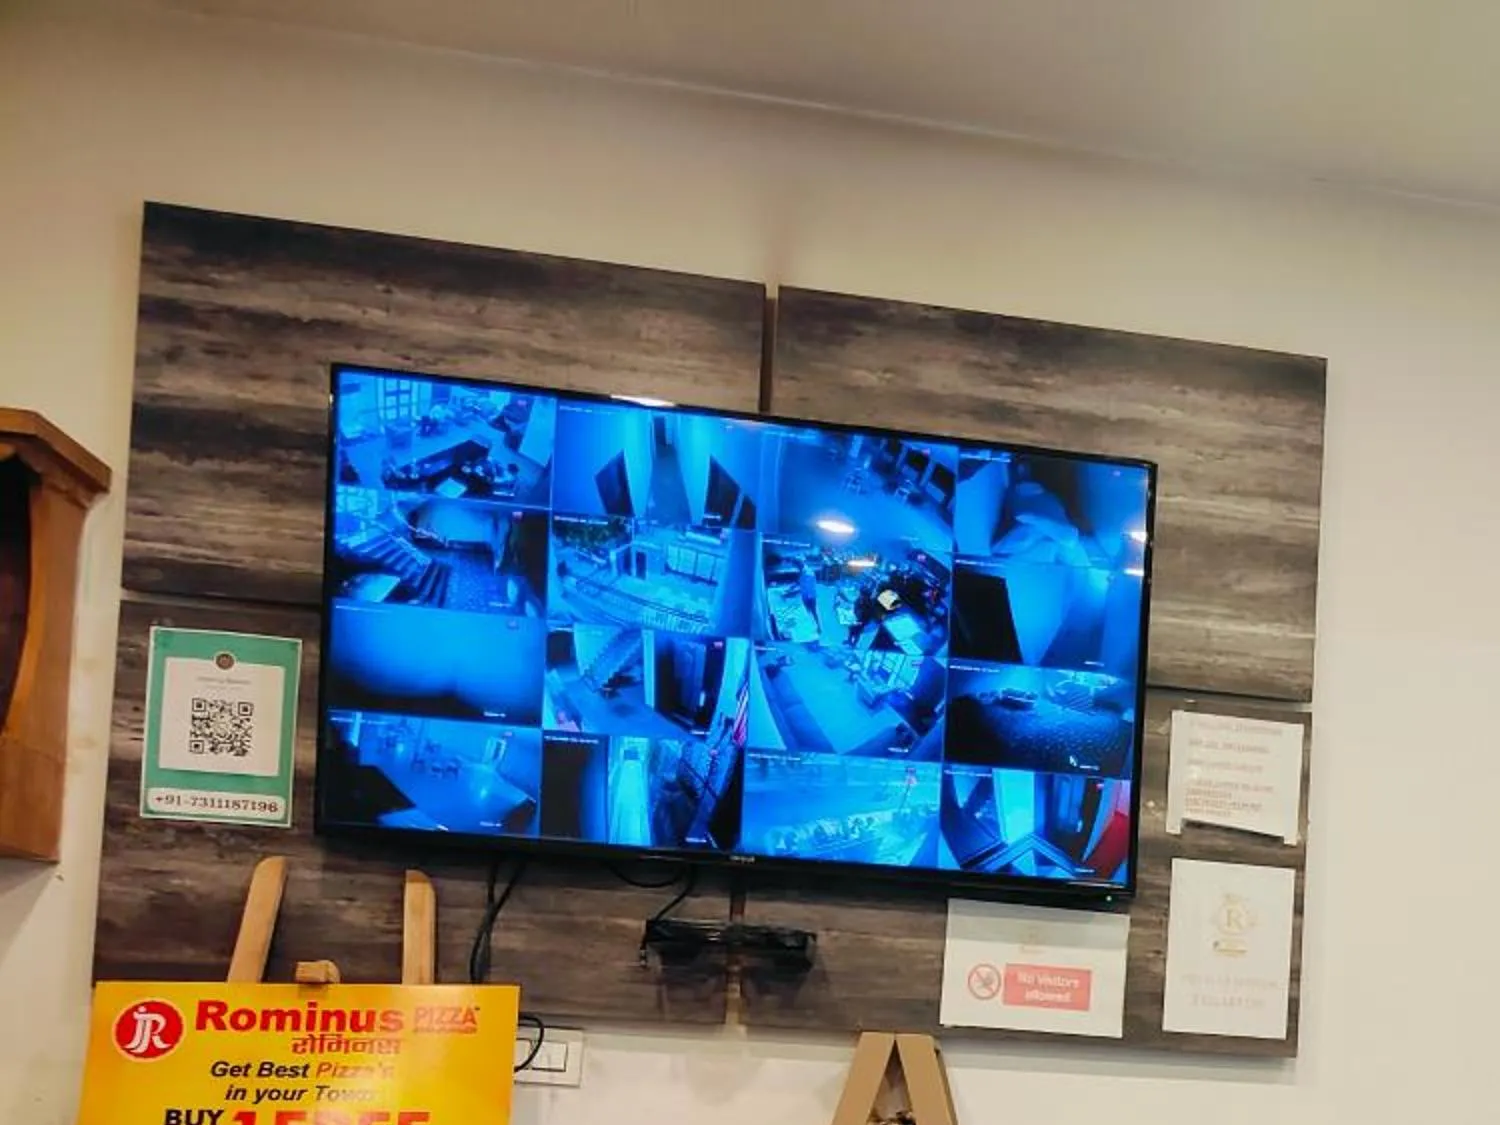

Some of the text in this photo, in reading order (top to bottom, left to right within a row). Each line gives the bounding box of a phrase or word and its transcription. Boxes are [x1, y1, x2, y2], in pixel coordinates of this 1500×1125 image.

[195, 999, 478, 1033] Rominus PIZZA
[210, 1060, 252, 1079] Get
[256, 1060, 310, 1079] Best
[225, 1084, 247, 1102] in
[252, 1086, 308, 1105] your
